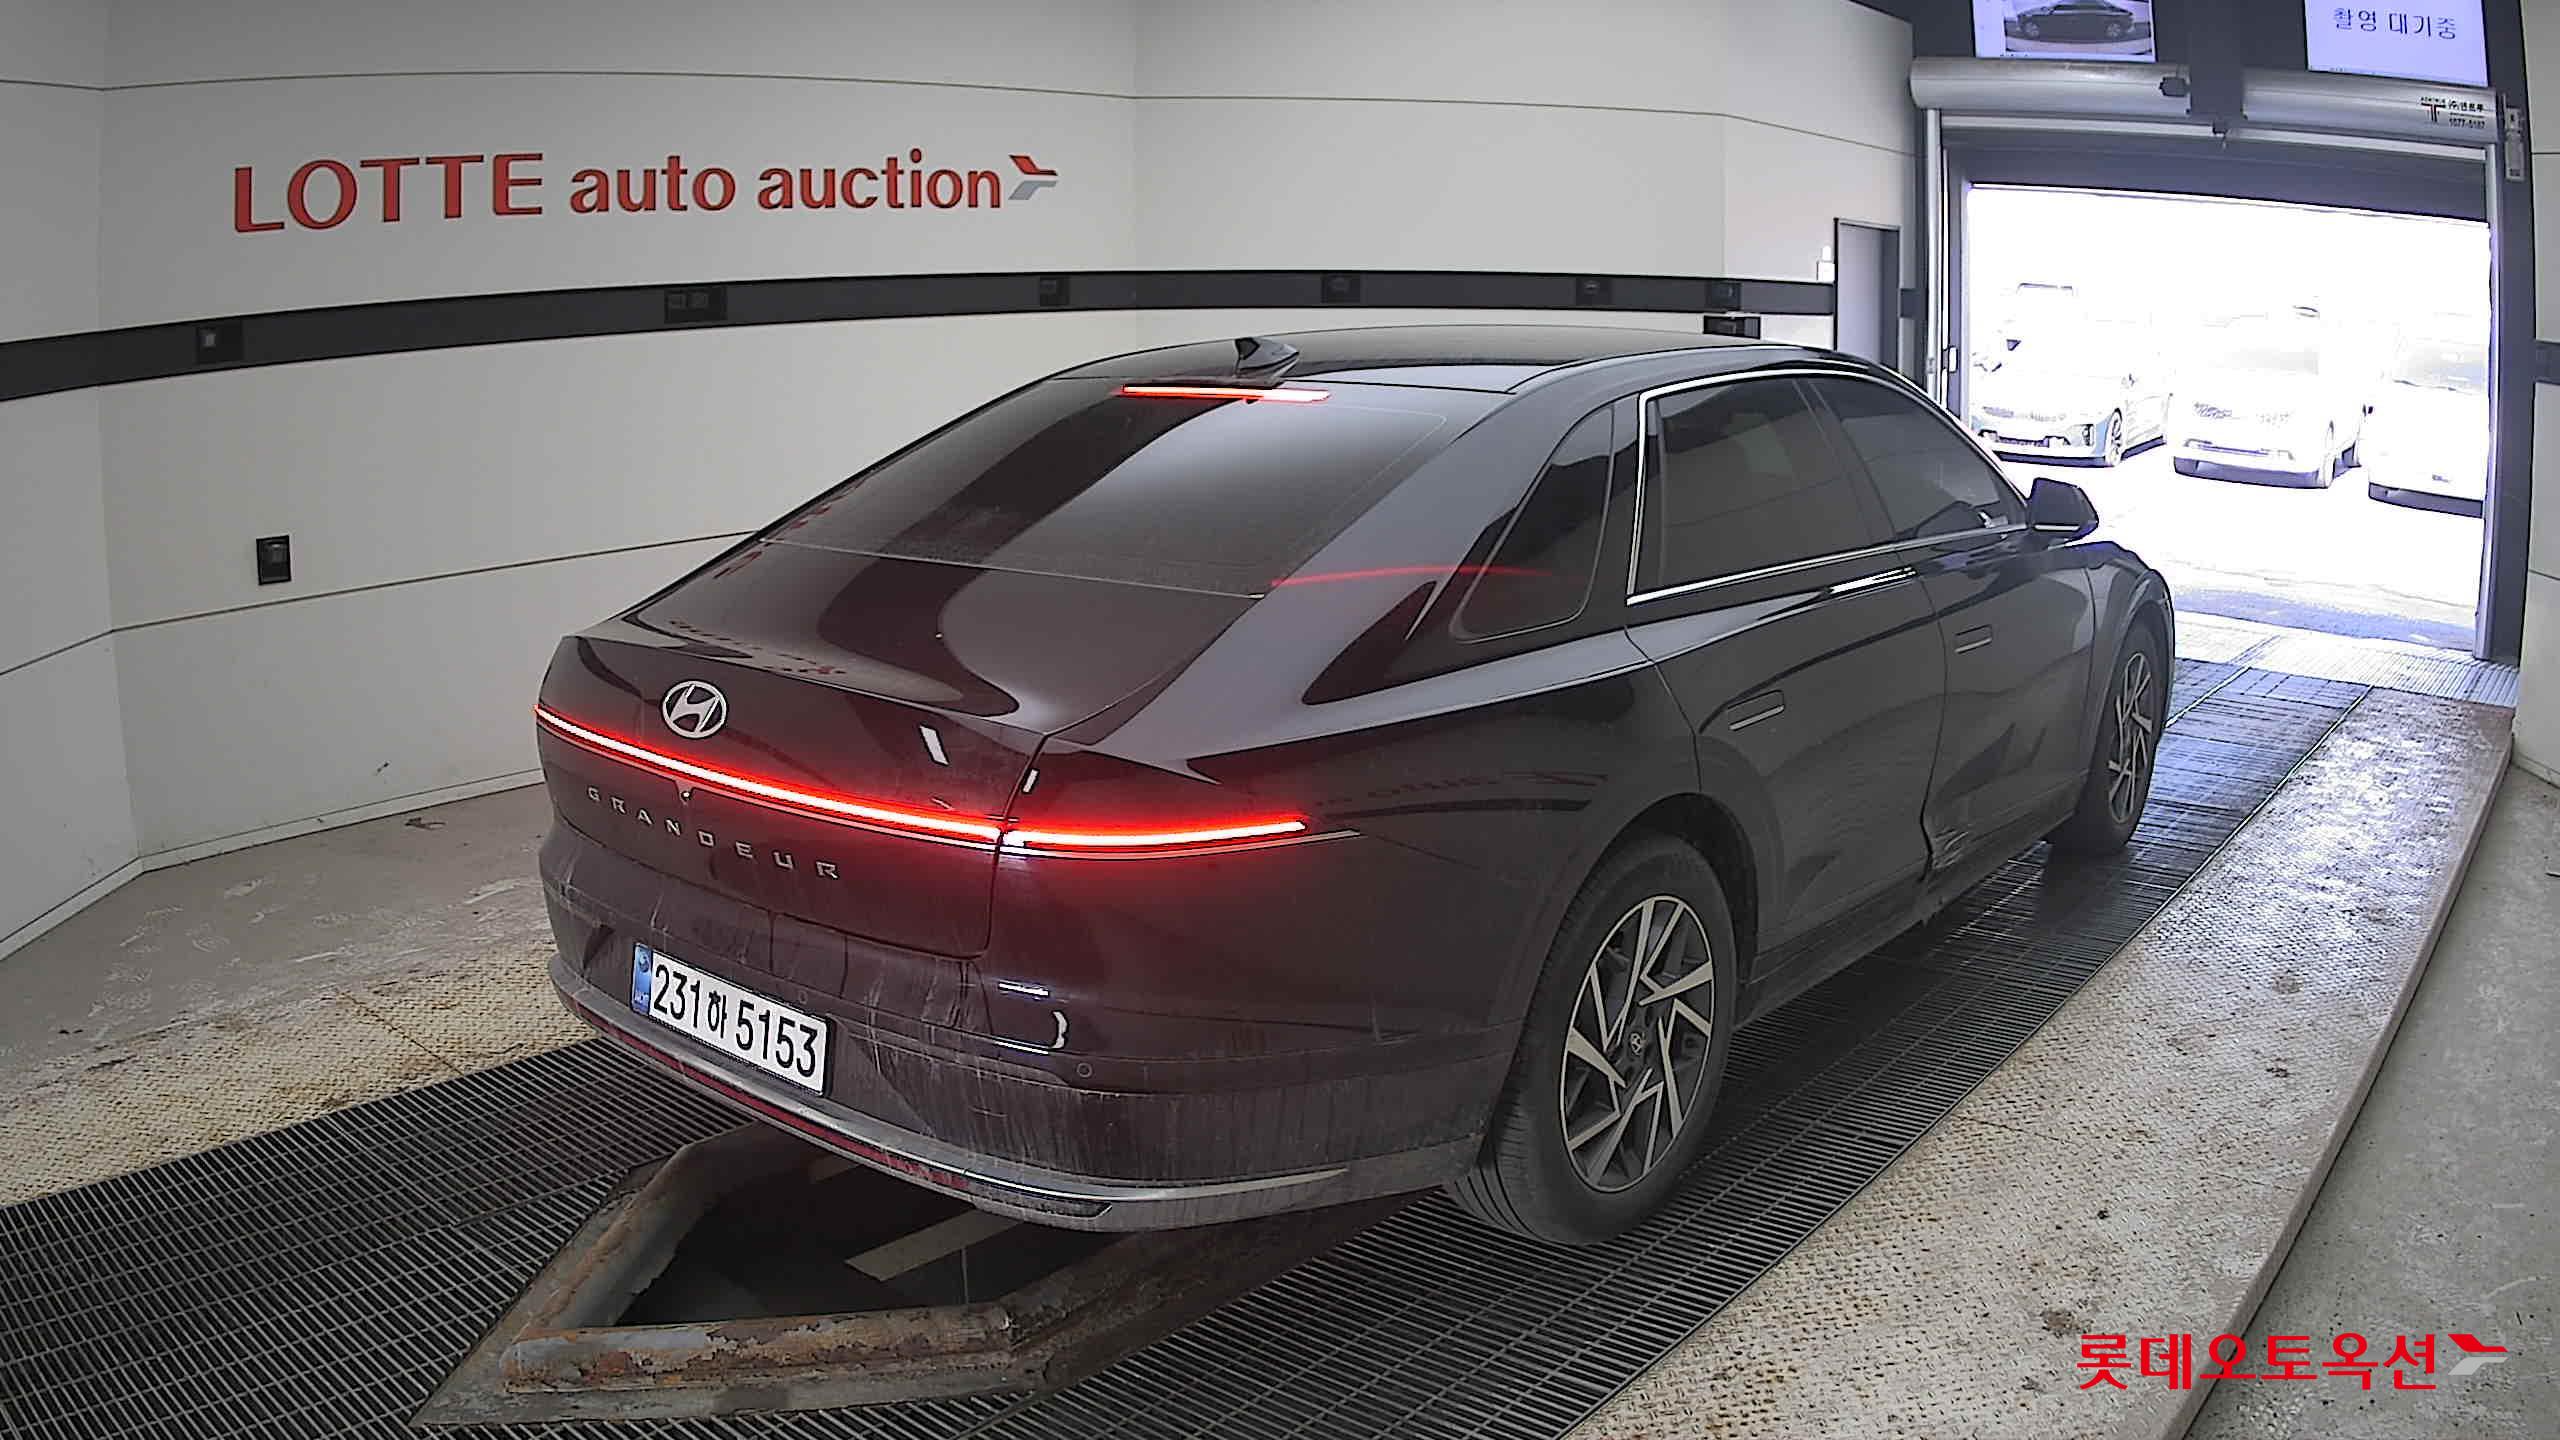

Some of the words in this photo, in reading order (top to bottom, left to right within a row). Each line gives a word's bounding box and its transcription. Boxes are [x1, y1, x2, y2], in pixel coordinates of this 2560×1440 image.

[2334, 8, 2377, 32] 촬영
[2388, 13, 2457, 40] 대기중
[233, 152, 544, 233] LOTTE
[569, 154, 737, 214] auto
[757, 147, 1002, 210] auction
[587, 786, 840, 880] GRANDEUR
[653, 964, 728, 1039] 231하
[734, 999, 819, 1078] 5153
